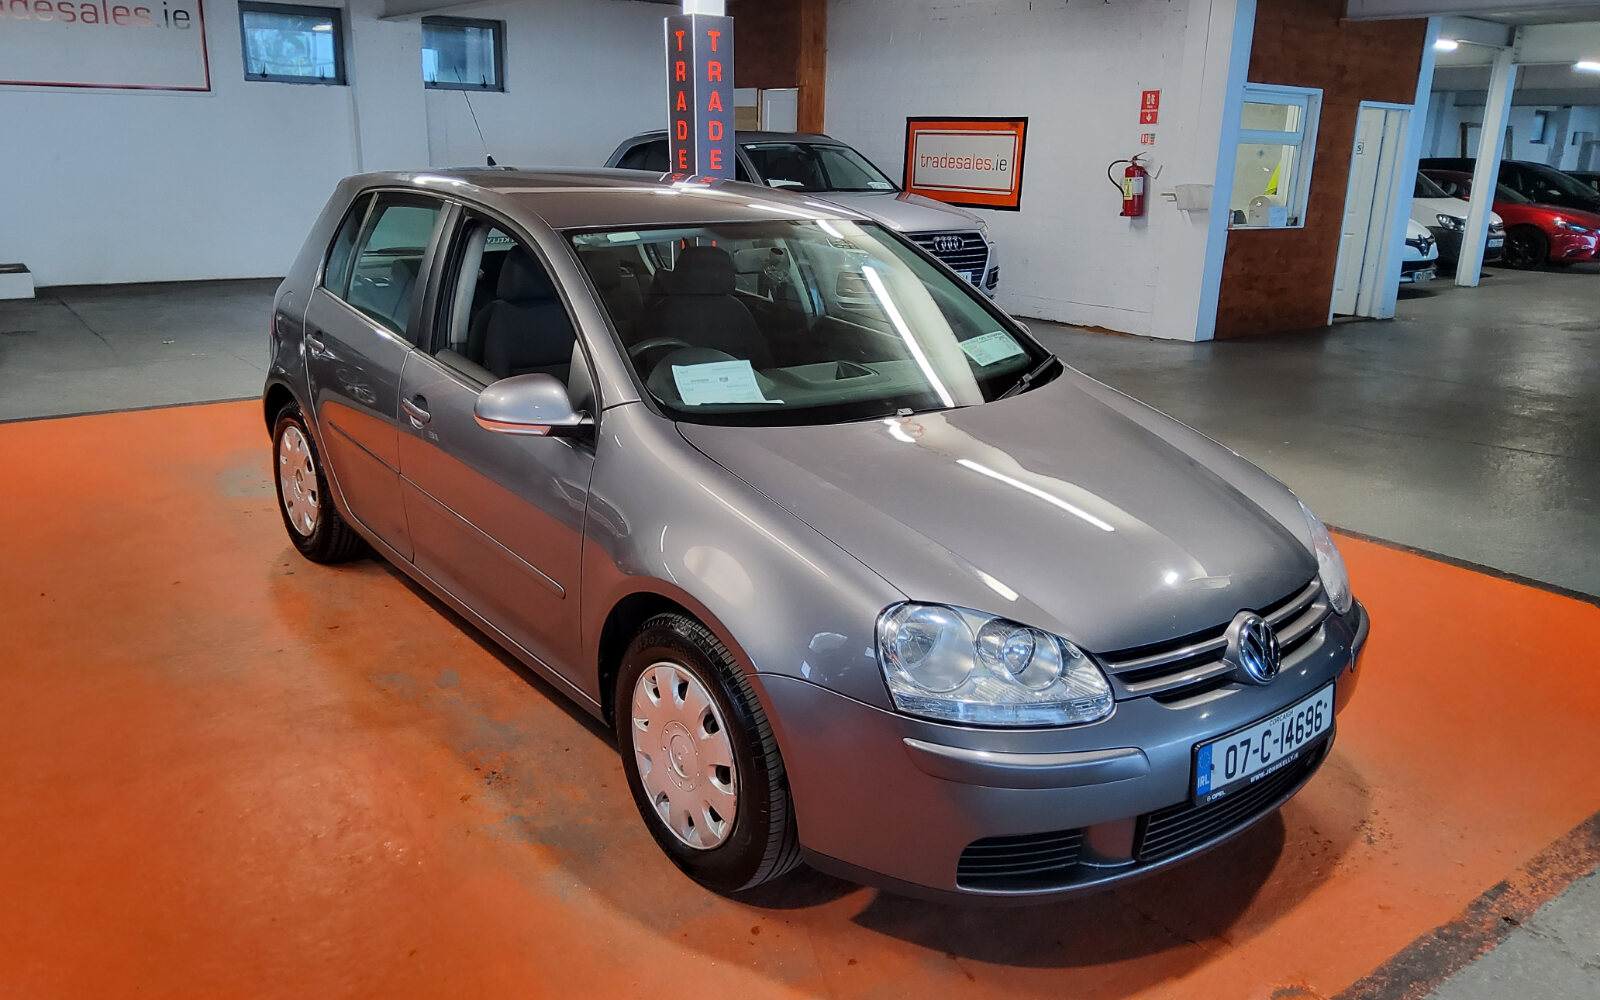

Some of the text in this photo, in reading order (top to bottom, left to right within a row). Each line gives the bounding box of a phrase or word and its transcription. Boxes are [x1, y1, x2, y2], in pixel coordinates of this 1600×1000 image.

[0, 0, 191, 30] desales.ie
[675, 30, 688, 170] TRADE
[707, 30, 723, 170] TRADE
[920, 152, 1008, 172] tradesales.ie
[1225, 699, 1323, 780] 07-C-14696
[1197, 775, 1210, 789] IRL
